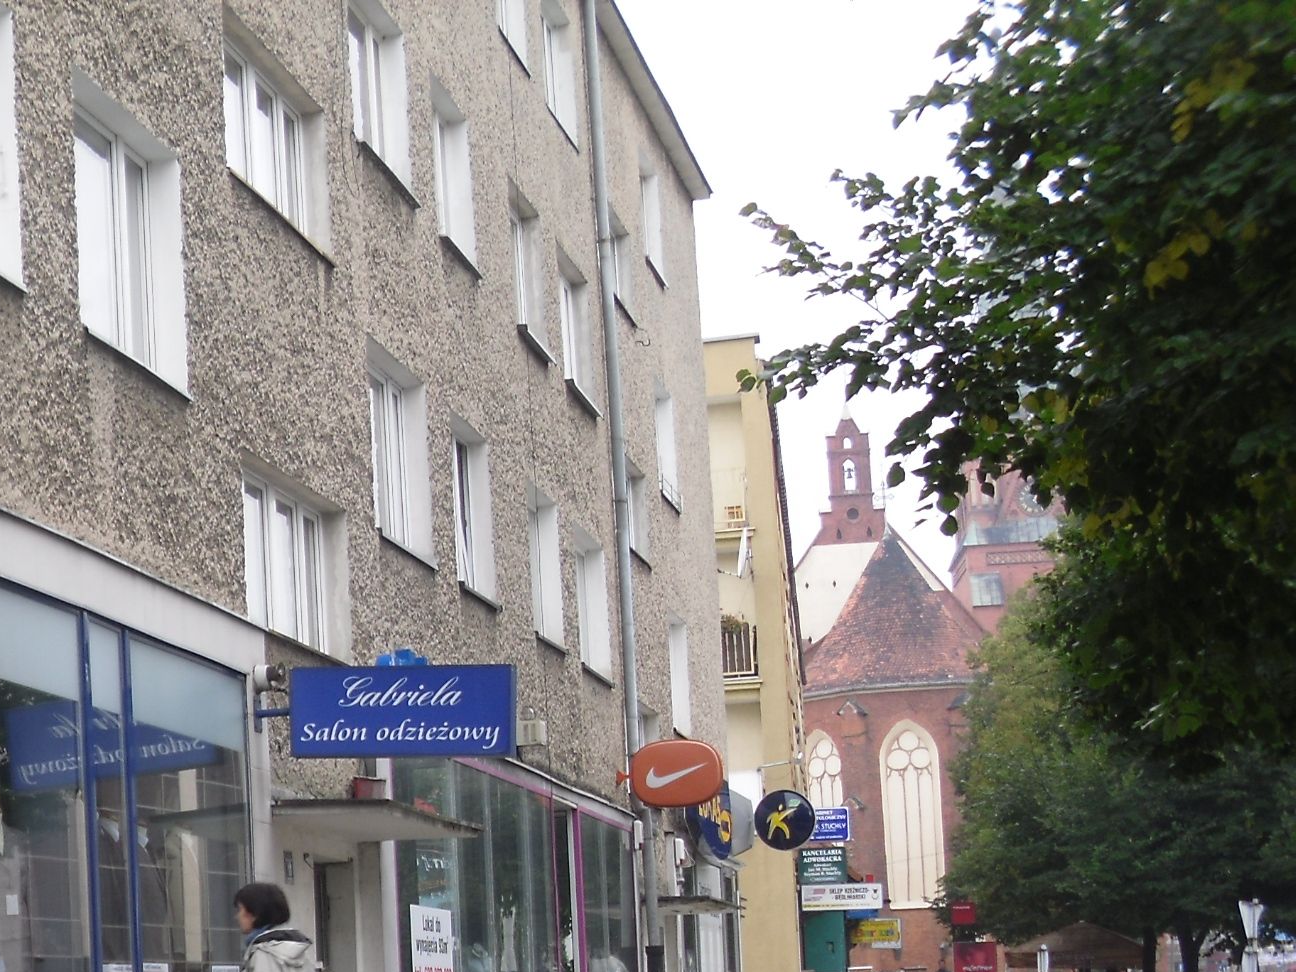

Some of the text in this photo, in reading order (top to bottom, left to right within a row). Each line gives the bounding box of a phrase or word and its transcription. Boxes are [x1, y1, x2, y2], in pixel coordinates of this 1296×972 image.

[338, 676, 462, 708] Gabriela
[300, 718, 500, 750] Salon odzieżowy
[802, 849, 842, 857] KANCELARIA
[422, 915, 441, 933] Lokal do
